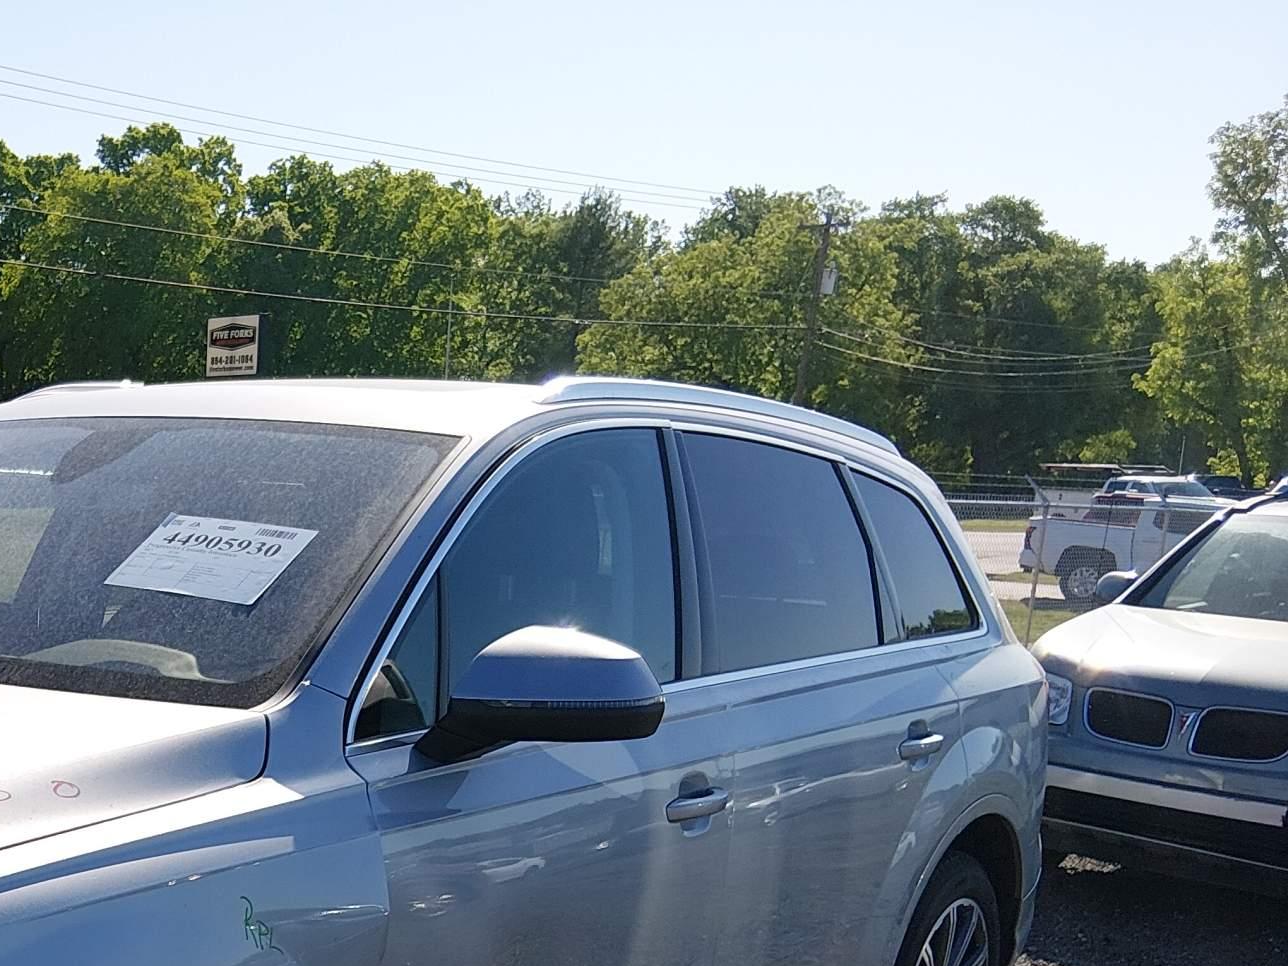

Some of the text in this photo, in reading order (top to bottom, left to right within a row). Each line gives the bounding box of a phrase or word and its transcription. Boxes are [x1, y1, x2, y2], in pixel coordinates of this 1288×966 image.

[213, 329, 254, 340] FIVE FORKS
[162, 531, 282, 558] 44905930
